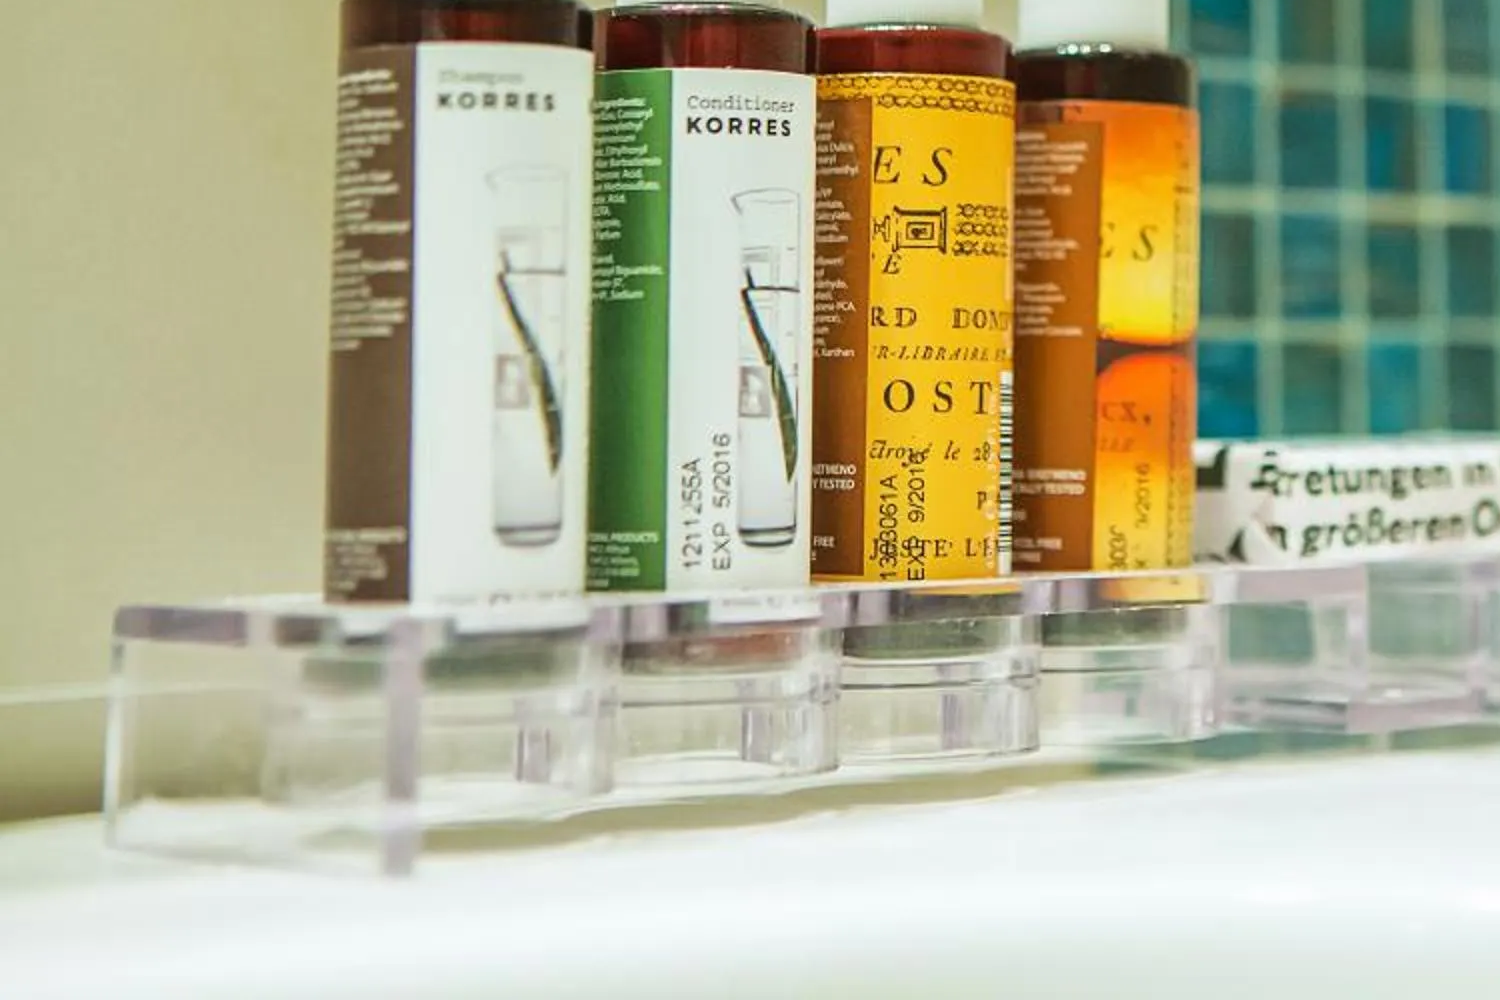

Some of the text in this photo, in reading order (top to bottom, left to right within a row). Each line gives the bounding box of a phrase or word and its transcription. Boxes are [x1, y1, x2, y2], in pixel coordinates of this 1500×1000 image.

[437, 92, 554, 112] KORRES
[687, 95, 795, 113] Conditioner
[687, 117, 791, 136] KORRES
[712, 433, 731, 571] EXP 5/2016
